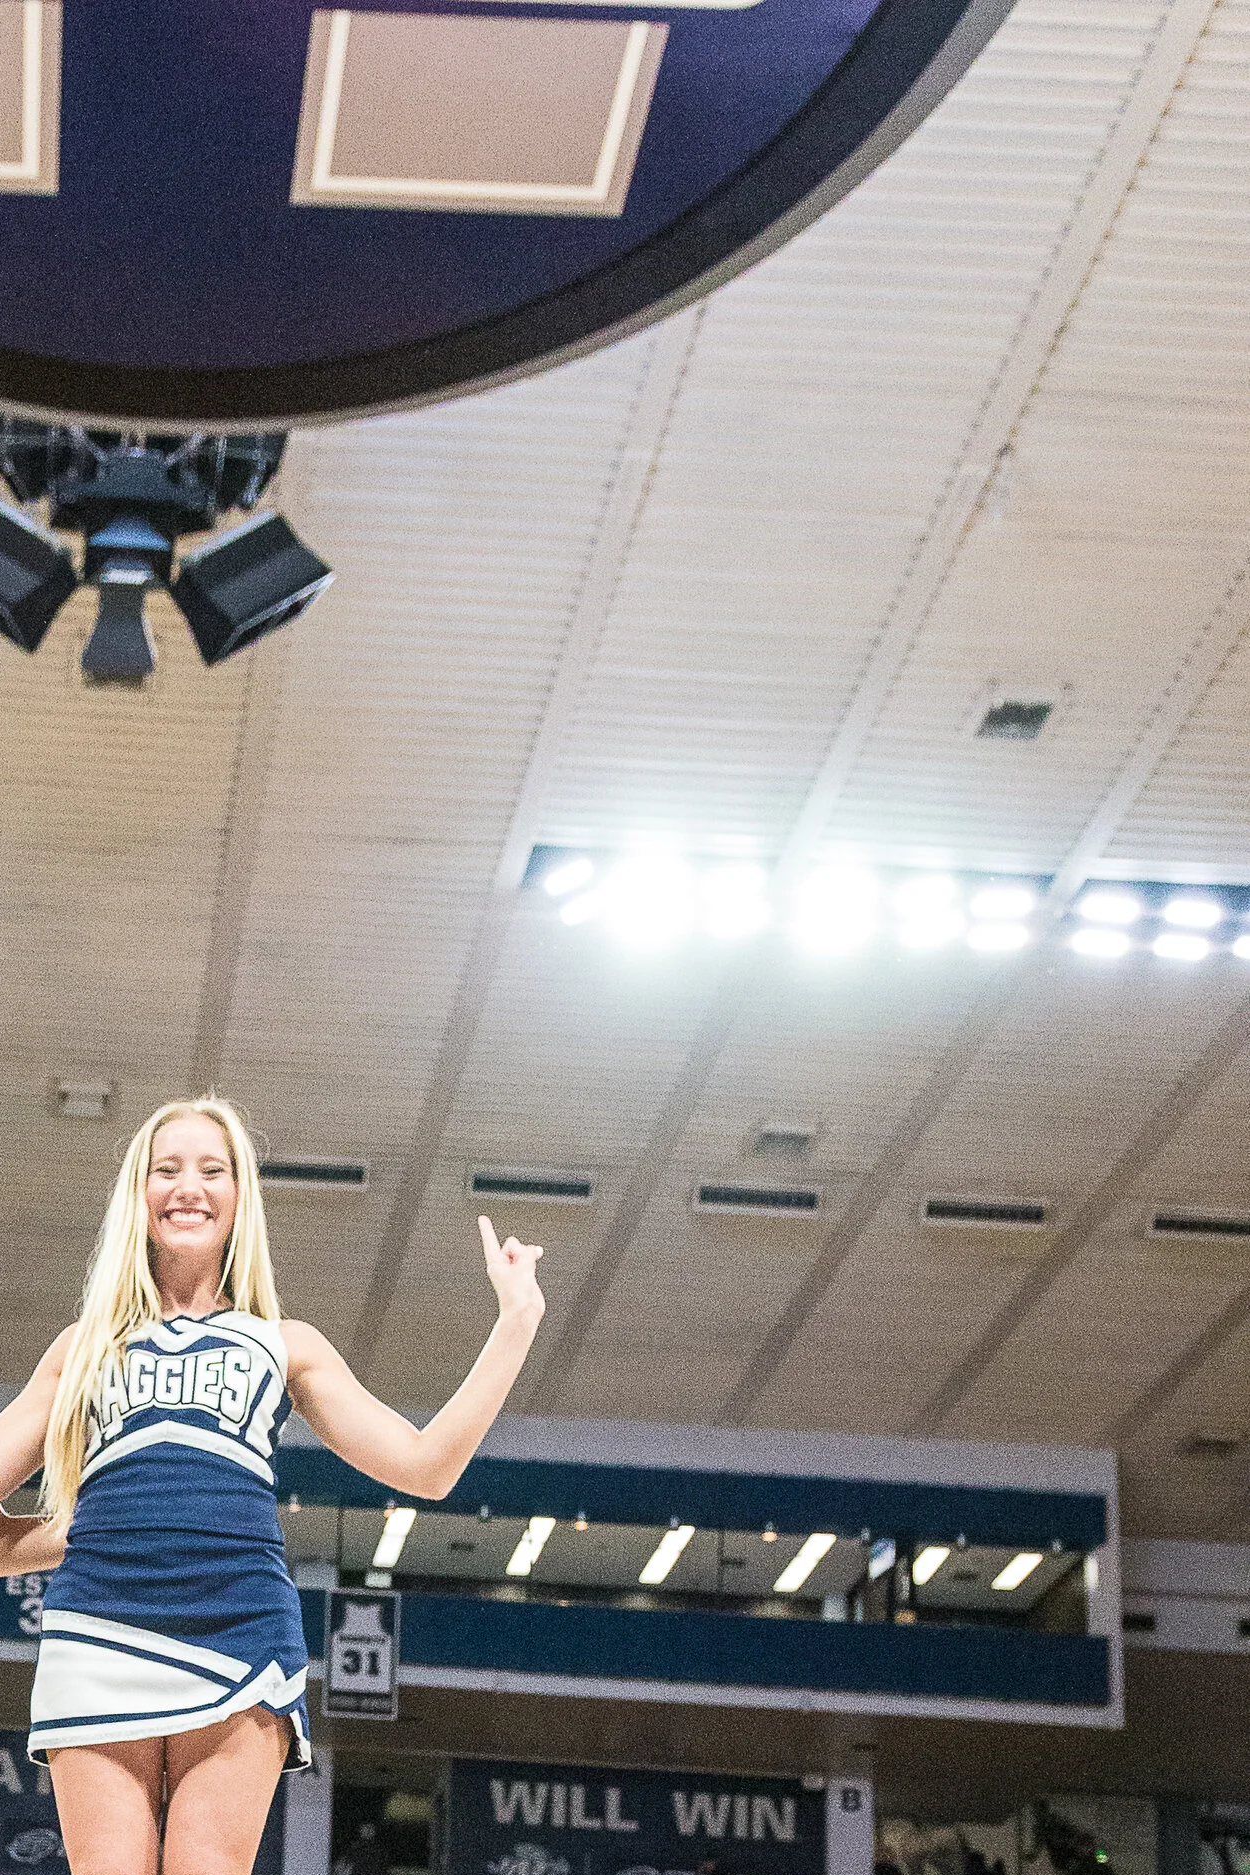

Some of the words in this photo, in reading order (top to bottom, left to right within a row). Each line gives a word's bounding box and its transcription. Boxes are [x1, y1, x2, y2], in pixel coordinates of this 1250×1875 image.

[98, 1346, 254, 1433] AGGIES
[341, 1649, 379, 1677] 31
[489, 1778, 639, 1833] WILL
[672, 1790, 797, 1843] WIN
[840, 1787, 861, 1814] B
